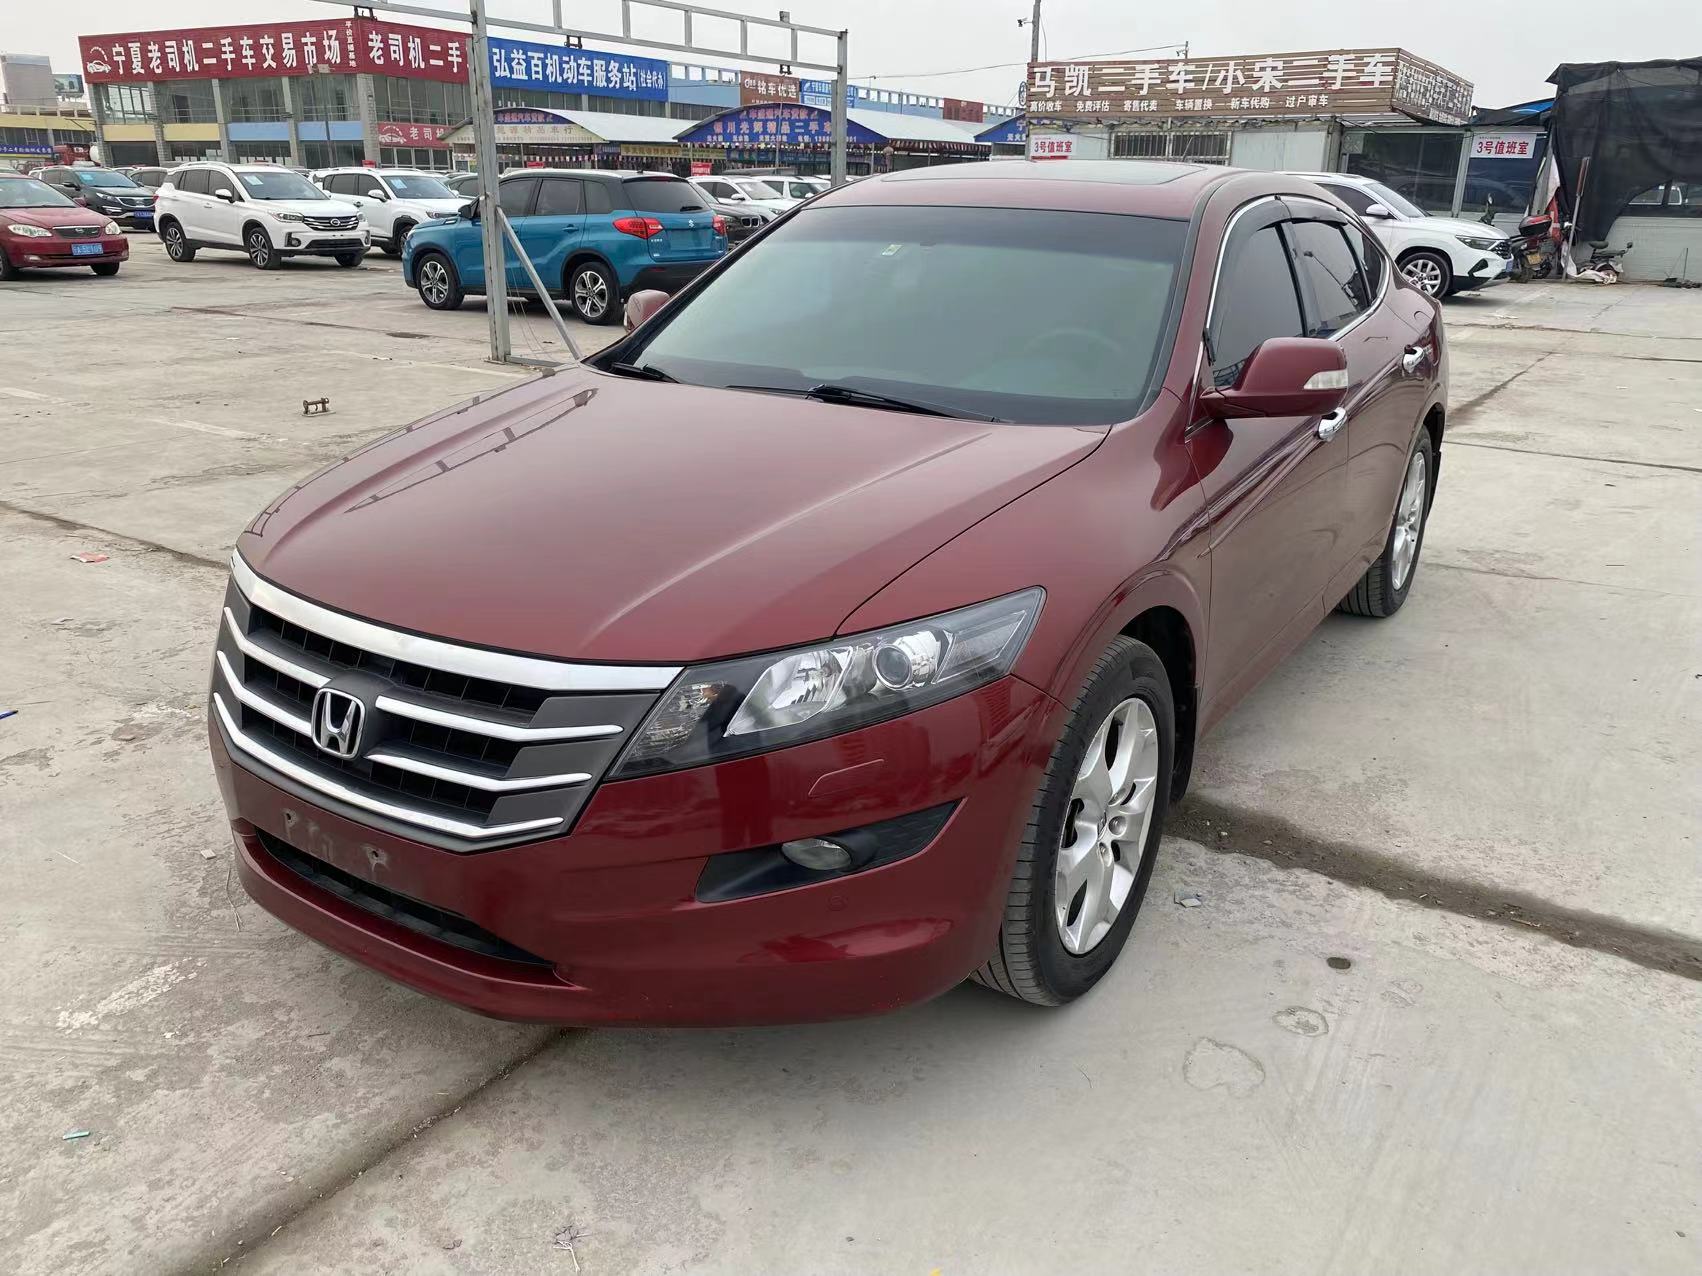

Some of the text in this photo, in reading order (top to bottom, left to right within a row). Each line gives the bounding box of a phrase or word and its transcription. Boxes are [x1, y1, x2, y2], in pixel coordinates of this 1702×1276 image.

[112, 29, 341, 74] 宁夏老司机二手车交易市场
[368, 30, 469, 73] 老司机二手
[1030, 53, 1396, 98] 马凯二手车/小宋二手车
[1030, 101, 1062, 112] 高价收车
[1076, 100, 1110, 112] 免费评估
[1175, 98, 1213, 111] 车辆置换
[1230, 97, 1270, 110] 新车代购
[1034, 141, 1073, 153] 3号值班室
[1476, 140, 1529, 155] 3号值班室
